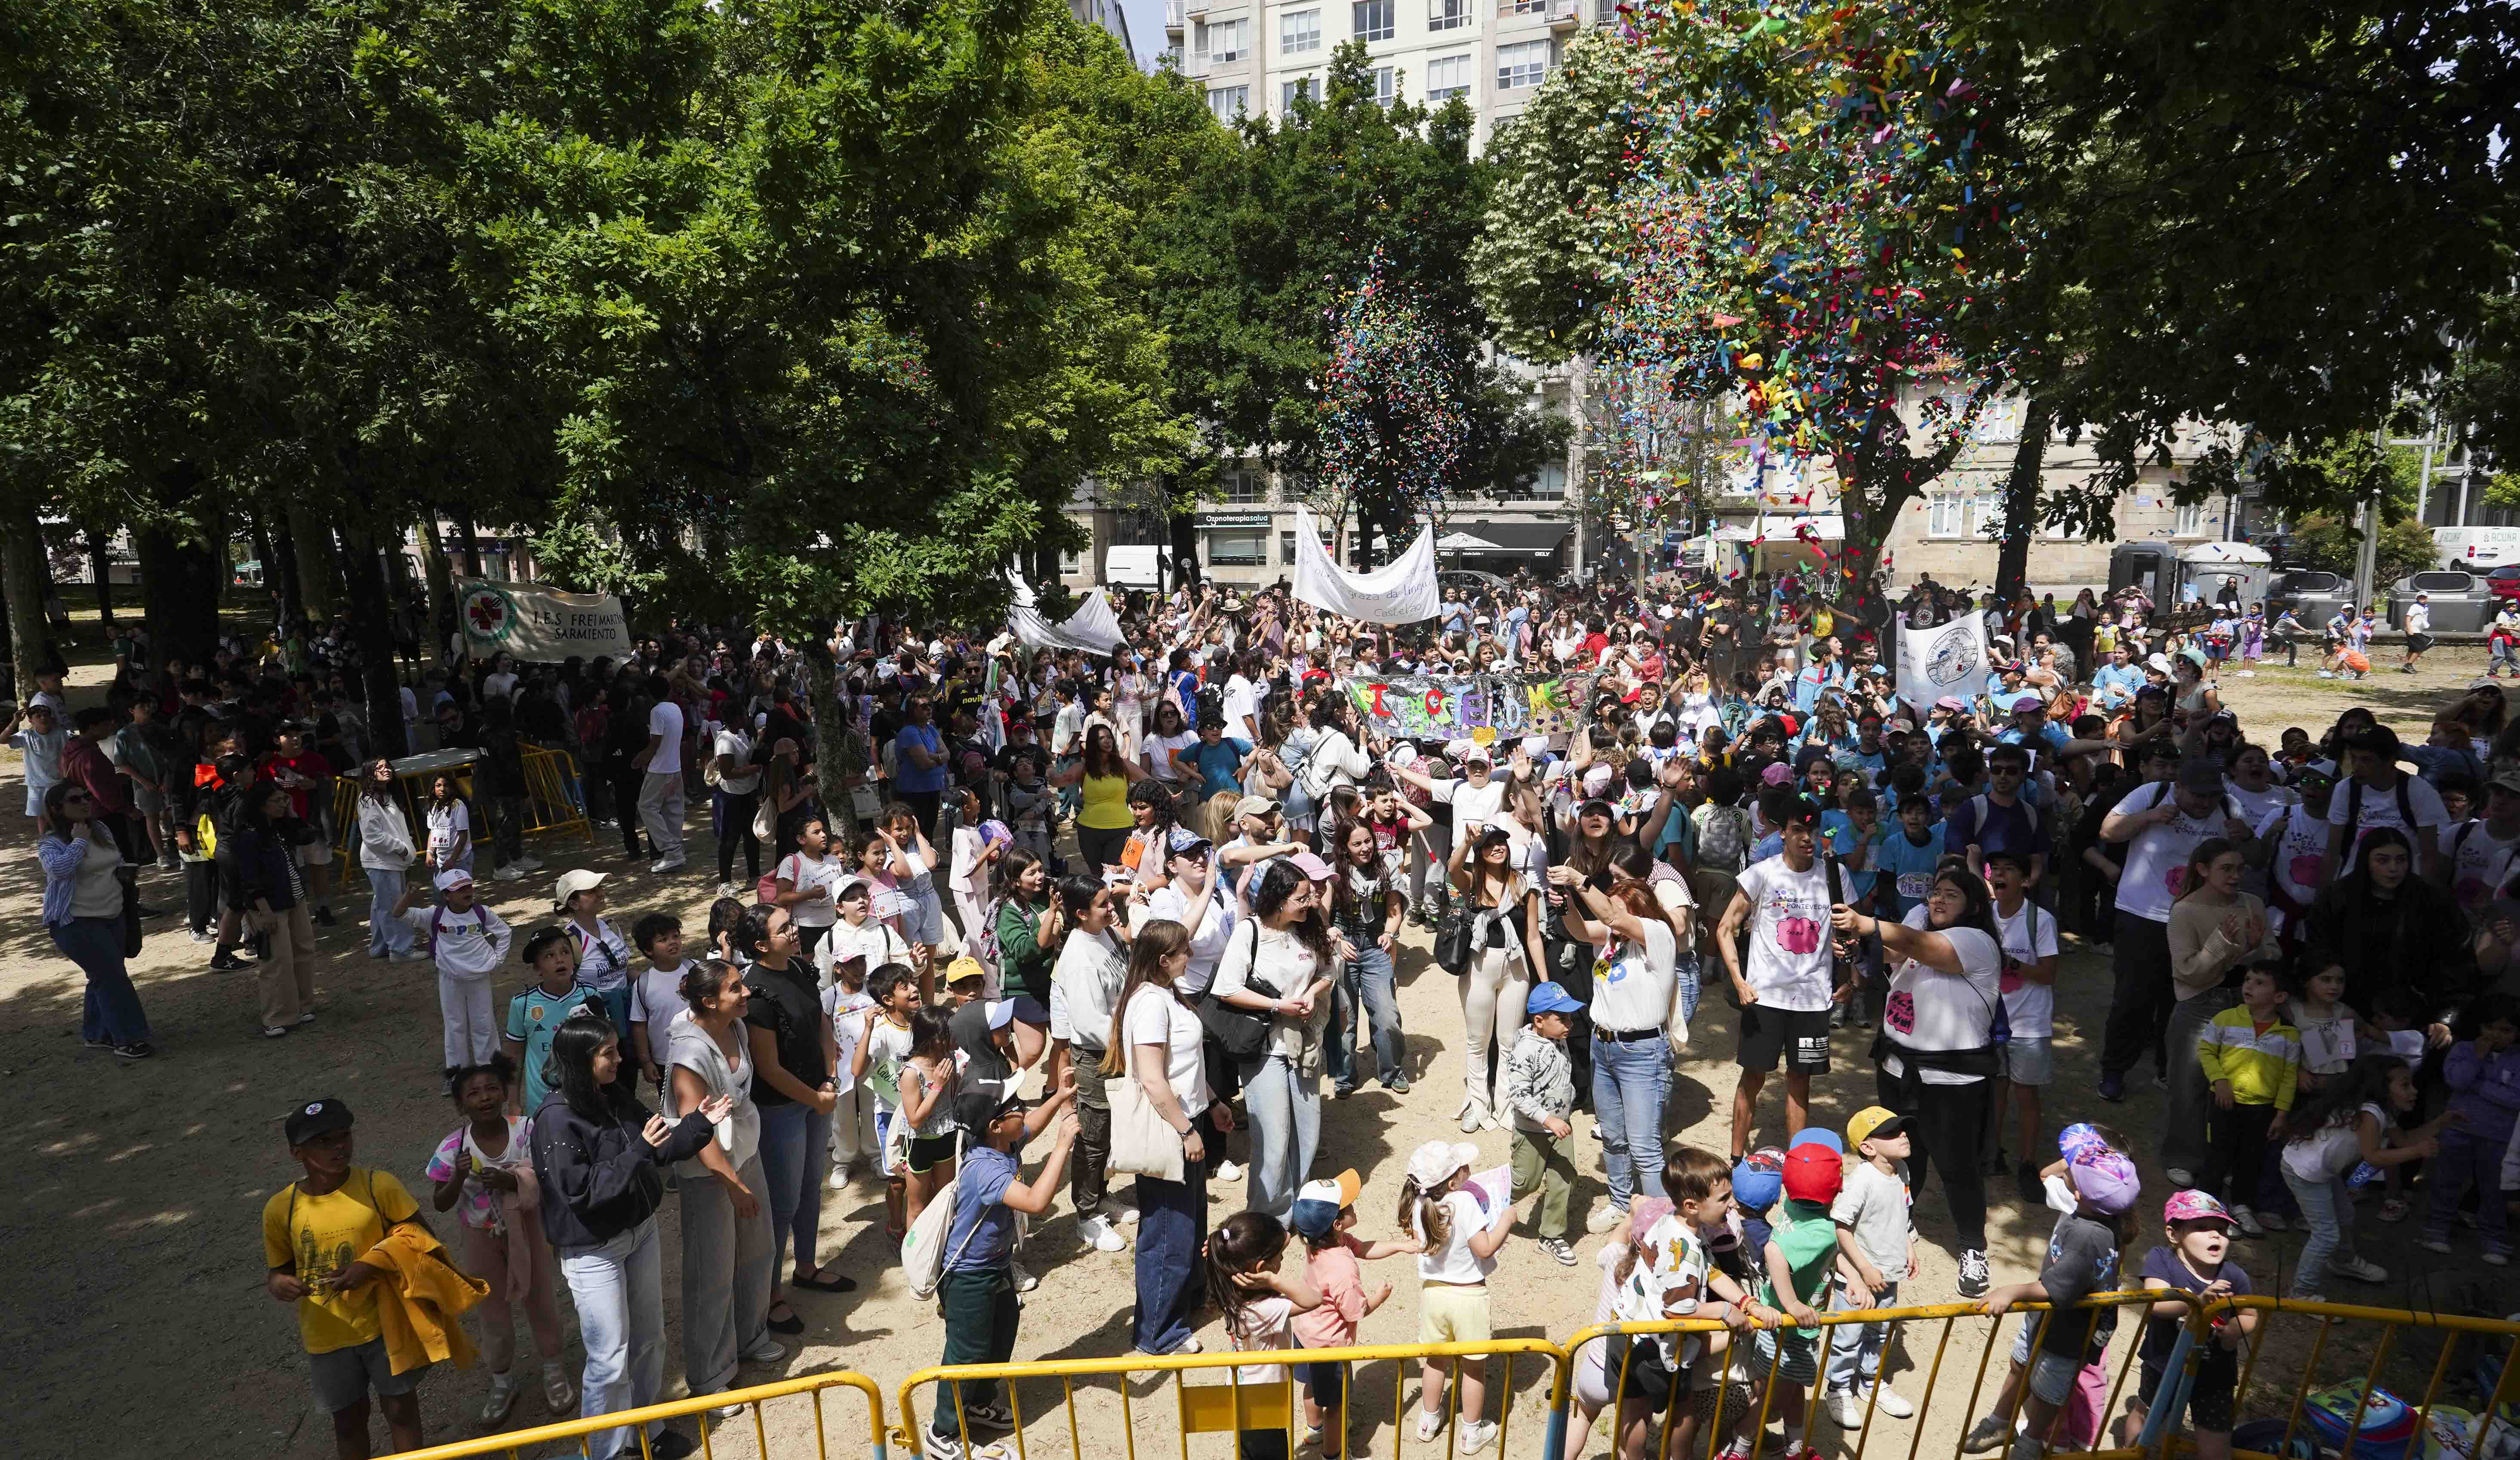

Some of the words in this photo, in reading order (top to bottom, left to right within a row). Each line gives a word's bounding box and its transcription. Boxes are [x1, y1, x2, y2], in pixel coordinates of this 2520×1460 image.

[1386, 590, 1398, 599] da
[571, 613, 597, 626] FREI
[555, 627, 616, 639] SARMIENTO
[962, 695, 984, 704] novib
